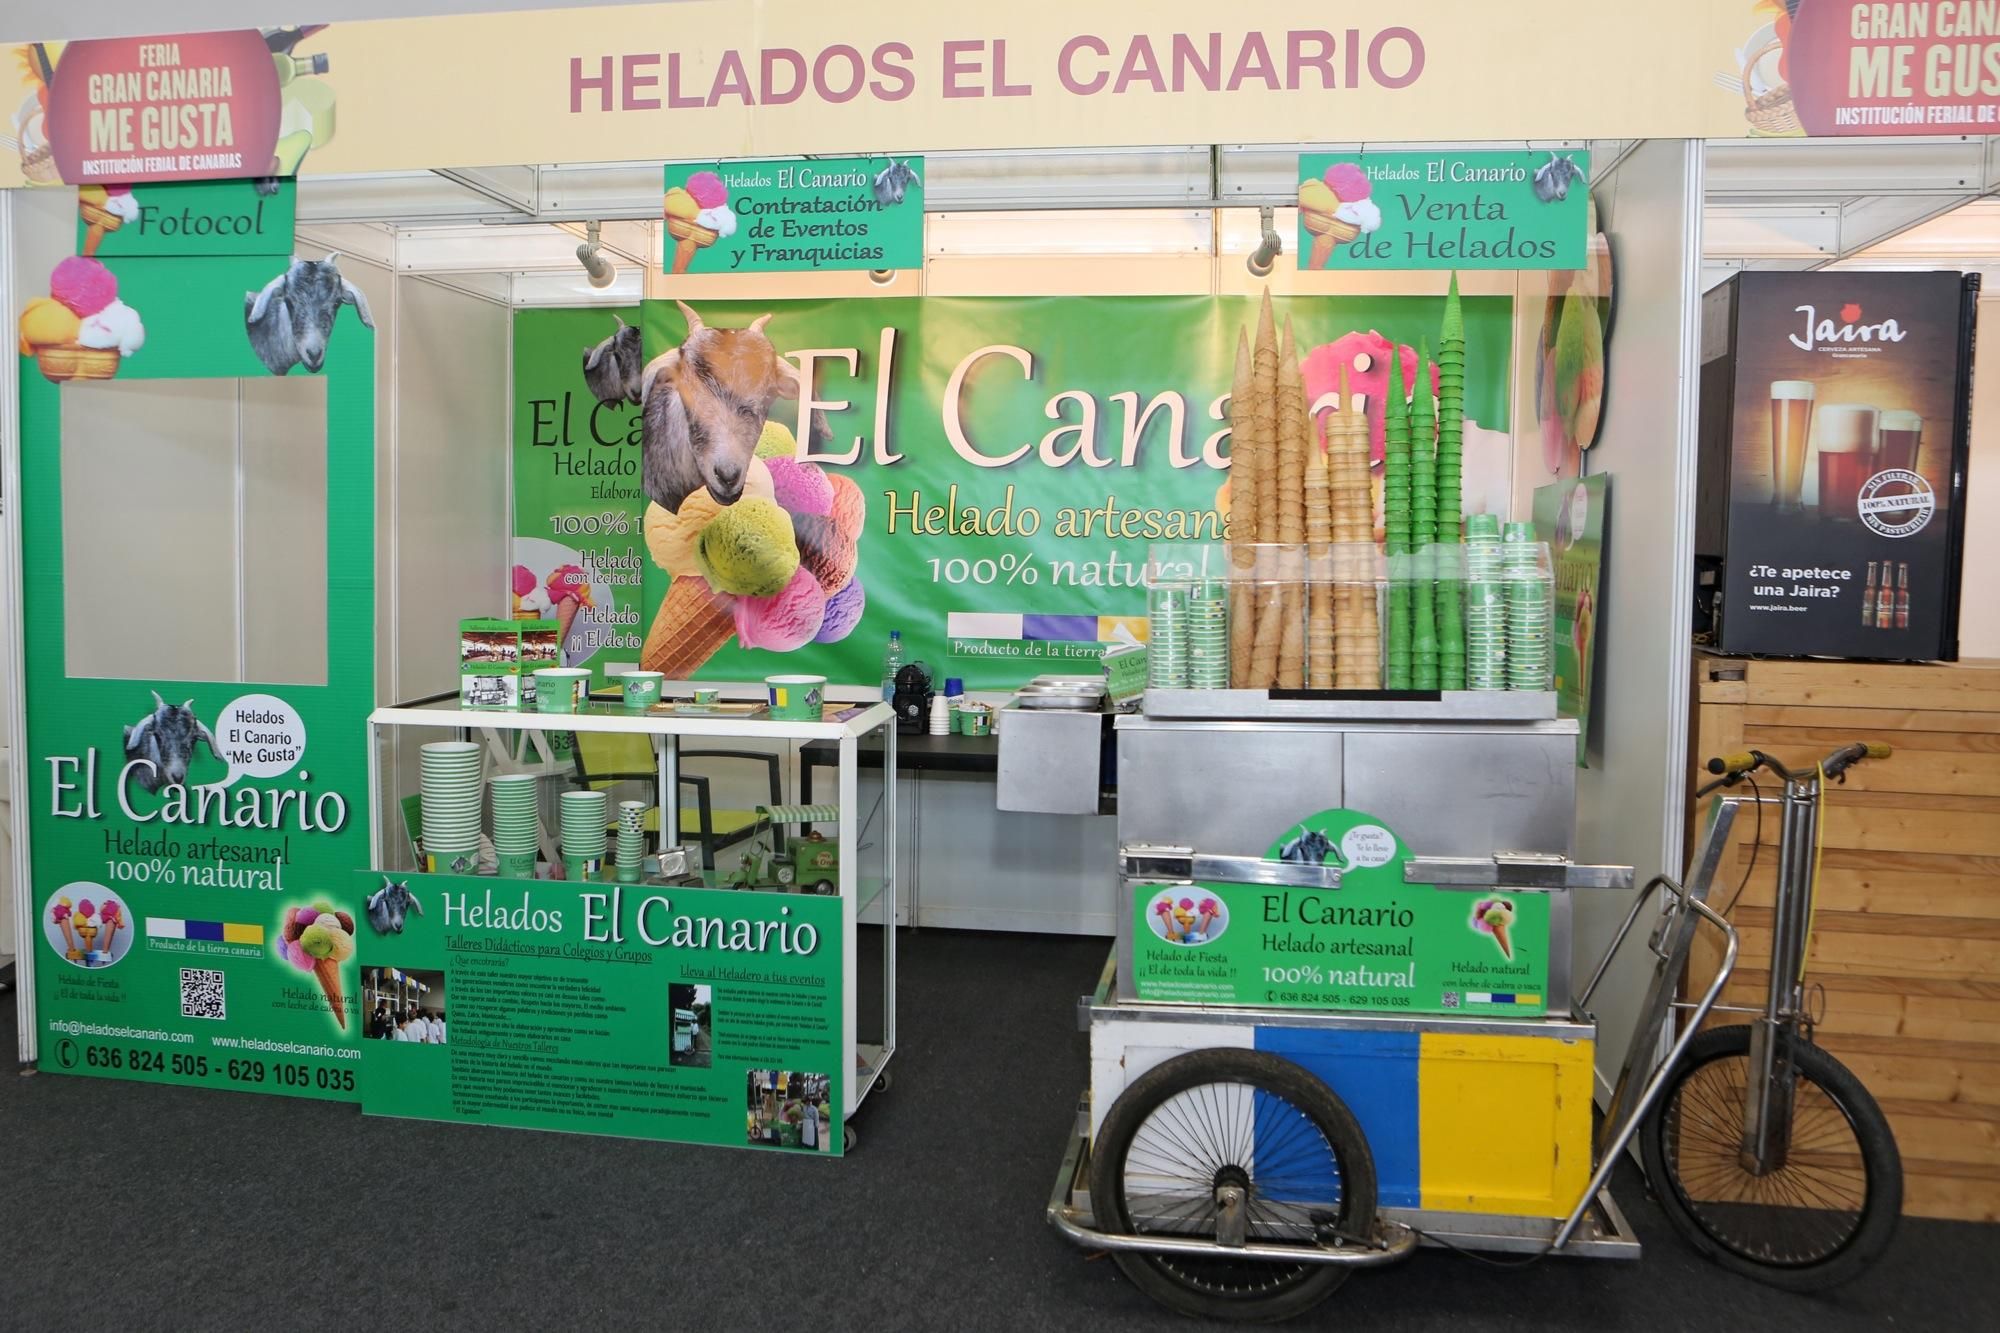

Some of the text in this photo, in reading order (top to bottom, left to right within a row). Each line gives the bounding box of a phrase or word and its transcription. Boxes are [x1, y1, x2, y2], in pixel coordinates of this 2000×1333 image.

[1850, 2, 1928, 40] GRAN
[139, 43, 181, 67] FERIA
[570, 26, 1425, 113] HELADOS EL CANARIO
[1848, 42, 2000, 98] ME GUS
[89, 67, 233, 104] GRAN CANARIA
[1835, 103, 1995, 125] INSTITUCIÓN FERIAL DE
[90, 102, 233, 153] ME GUSTA
[82, 153, 242, 175] INSTITUCIÓN FERIAL DE CANARIAS
[1367, 160, 1526, 183] Helados El Canario
[724, 166, 867, 189] Helados El Canario
[138, 200, 264, 236] Fotocol
[735, 194, 883, 217] Contratación
[1396, 194, 1509, 221] Venta
[748, 218, 868, 239] de Eventos
[1350, 227, 1556, 259] de Helados
[730, 243, 883, 269] y Franquicias
[1789, 304, 1907, 351] Jaira
[785, 327, 905, 467] El
[527, 391, 575, 448] El
[553, 448, 637, 477] Helado
[886, 484, 1041, 536] Helado
[1887, 495, 1930, 507] NATURAL
[550, 511, 630, 536] 100%
[580, 547, 642, 570] Helado
[927, 544, 1209, 588] 100% natural
[564, 566, 627, 585] con leche
[1749, 565, 1851, 581] ¿Te apetece
[1753, 584, 1840, 598] una Jaira?
[581, 604, 639, 624] Helado
[1749, 604, 1808, 612] www.jaira.beer
[586, 630, 603, 648] El
[608, 630, 623, 648] de
[954, 641, 1107, 658] Producto de la tierra
[235, 710, 284, 725] Helados
[229, 729, 292, 745] El Canario
[45, 747, 347, 834] El Canario
[103, 827, 291, 865] Helado artesanal
[105, 856, 284, 890] 100% natural
[441, 886, 819, 956] Helados El Canario
[1261, 892, 1414, 928] El Canario
[150, 938, 261, 958] Producto de la tierra canaria
[445, 935, 652, 965] Talleres Didácticos para Colegios y Grupos
[1146, 949, 1228, 963] Helado de Fiesta
[1262, 932, 1413, 957] Helado artesanal
[680, 964, 705, 979] Lleva
[707, 968, 716, 978] al
[718, 967, 761, 981] Heladero
[771, 971, 787, 984] tus
[789, 974, 825, 986] eventos
[1149, 963, 1227, 977] El de toda la vida
[1262, 962, 1416, 988] 100% natural
[1452, 961, 1530, 975] Helado natural
[282, 986, 358, 1005] Helado natural
[1280, 992, 1298, 1001] 636
[1302, 993, 1320, 1002] 824
[1322, 994, 1340, 1003] 505
[1349, 995, 1368, 1004] 629
[1372, 996, 1389, 1006] 105
[1391, 997, 1410, 1006] 035
[49, 1019, 361, 1060] info@heladoselcanario.com www.heladoselcanario.com
[87, 1045, 122, 1069] 636
[129, 1050, 165, 1072] 824
[172, 1053, 208, 1077] 505
[228, 1059, 265, 1083] 629
[273, 1063, 309, 1087] 105
[317, 1067, 355, 1091] 035
